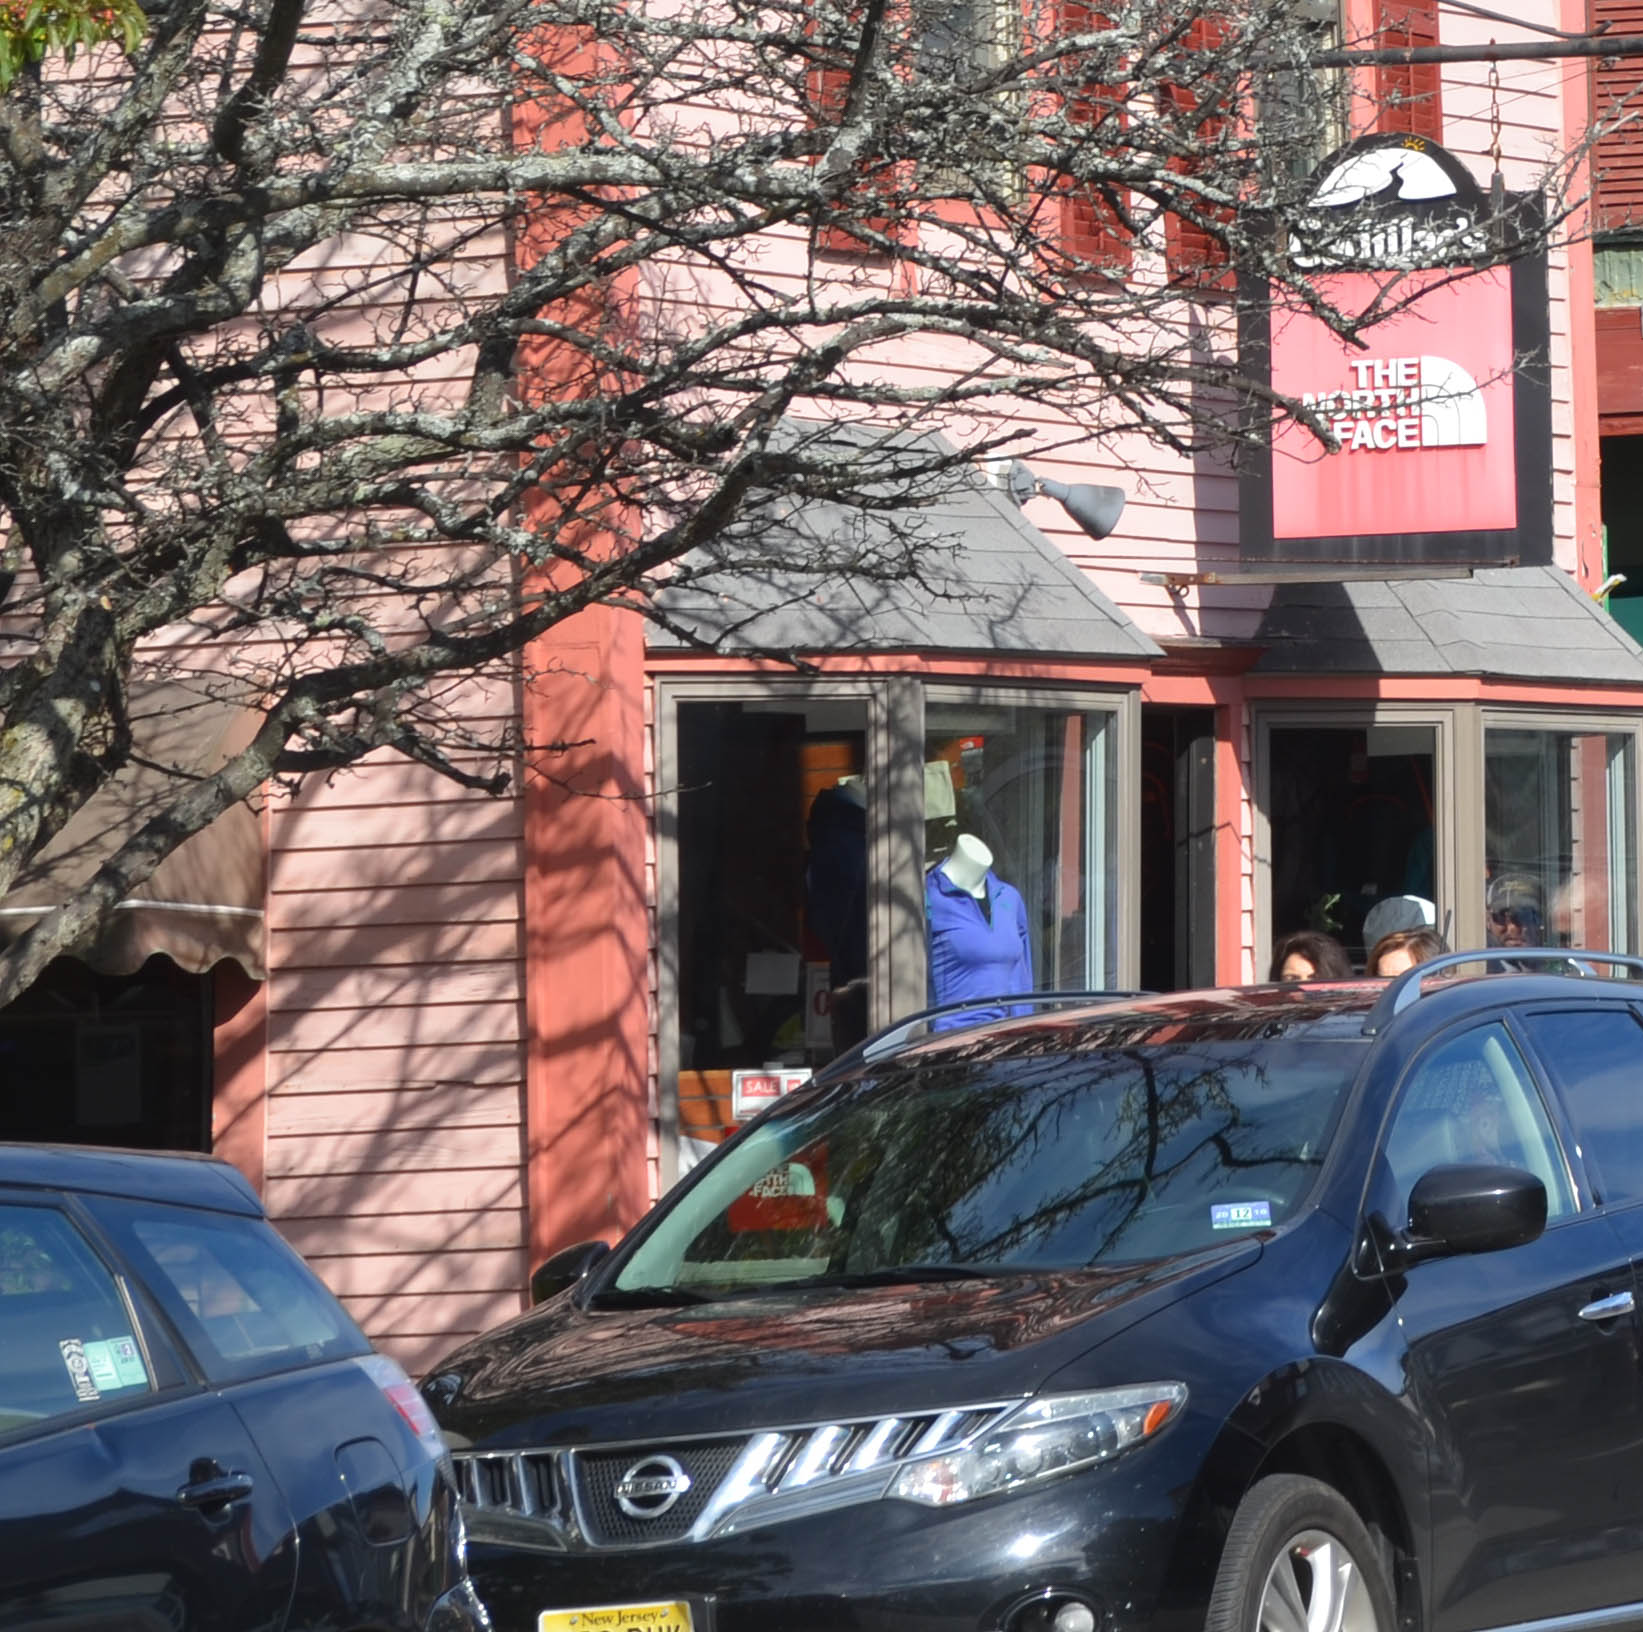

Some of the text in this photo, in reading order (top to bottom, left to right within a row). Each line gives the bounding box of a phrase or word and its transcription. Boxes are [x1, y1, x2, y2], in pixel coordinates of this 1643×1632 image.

[1351, 357, 1420, 389] THE
[1302, 388, 1420, 421] NORTH
[1332, 419, 1421, 450] FACE
[580, 1606, 658, 1626] New Jersey
